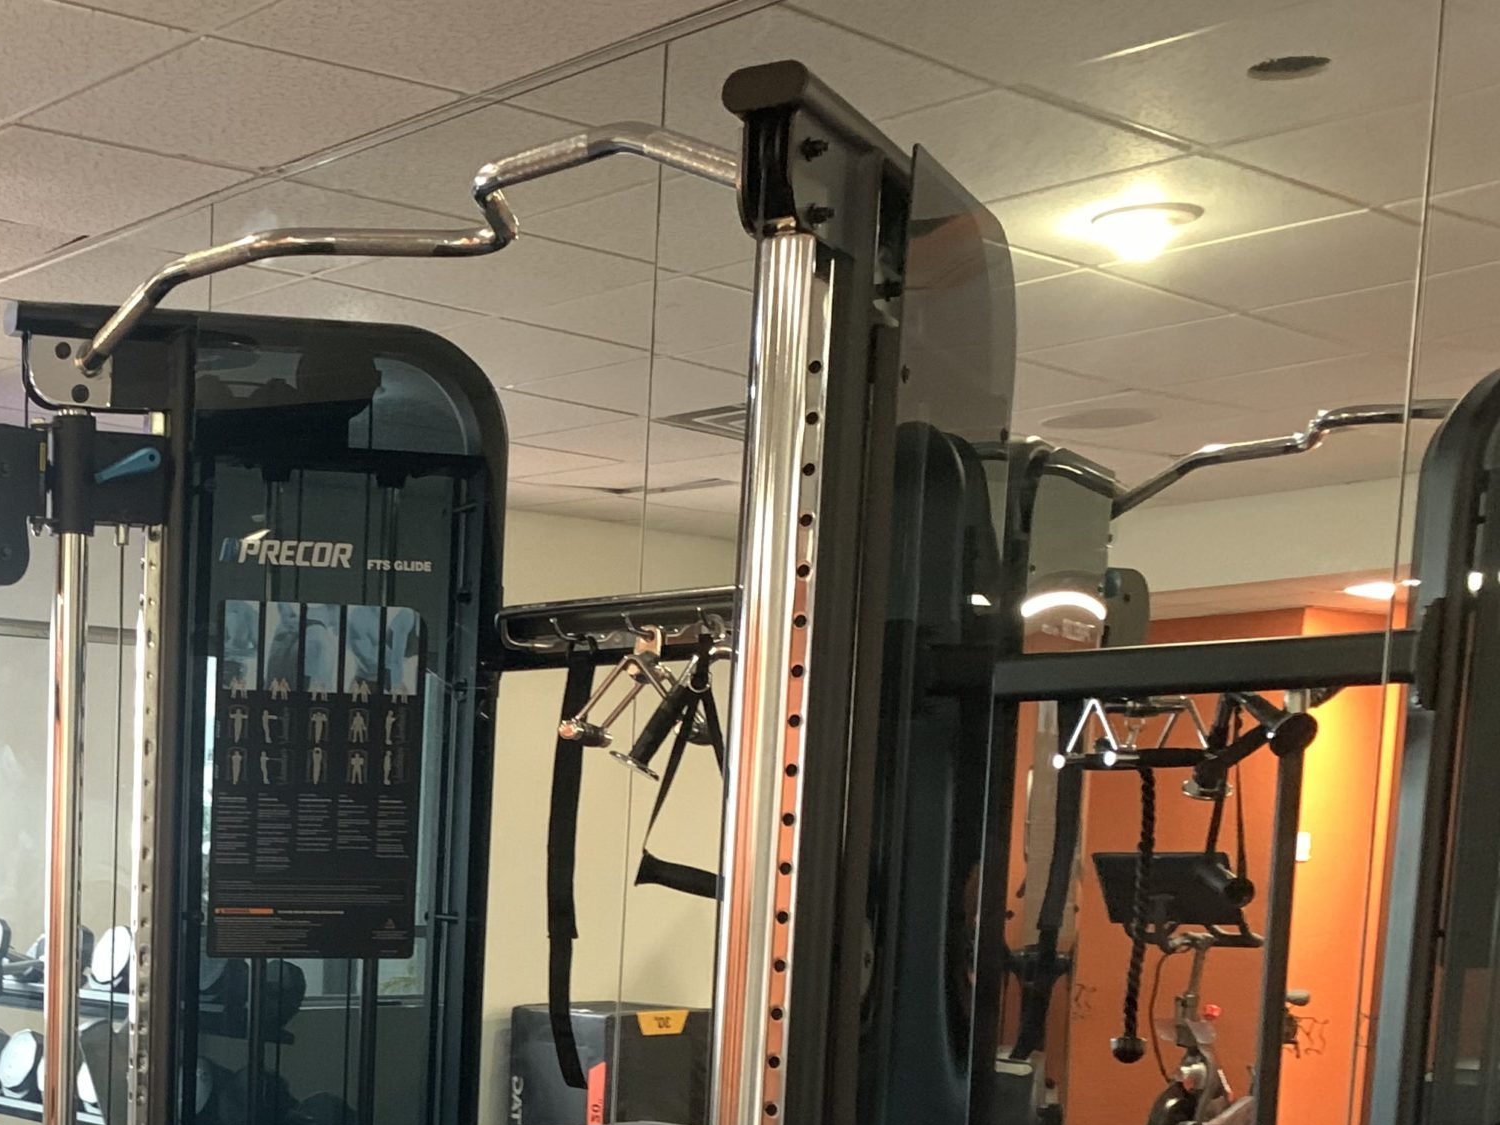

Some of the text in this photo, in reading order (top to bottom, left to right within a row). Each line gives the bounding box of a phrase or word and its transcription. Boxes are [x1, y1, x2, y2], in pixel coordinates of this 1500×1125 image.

[238, 539, 353, 568] PRECOR
[367, 559, 432, 572] FTS GLIDE
